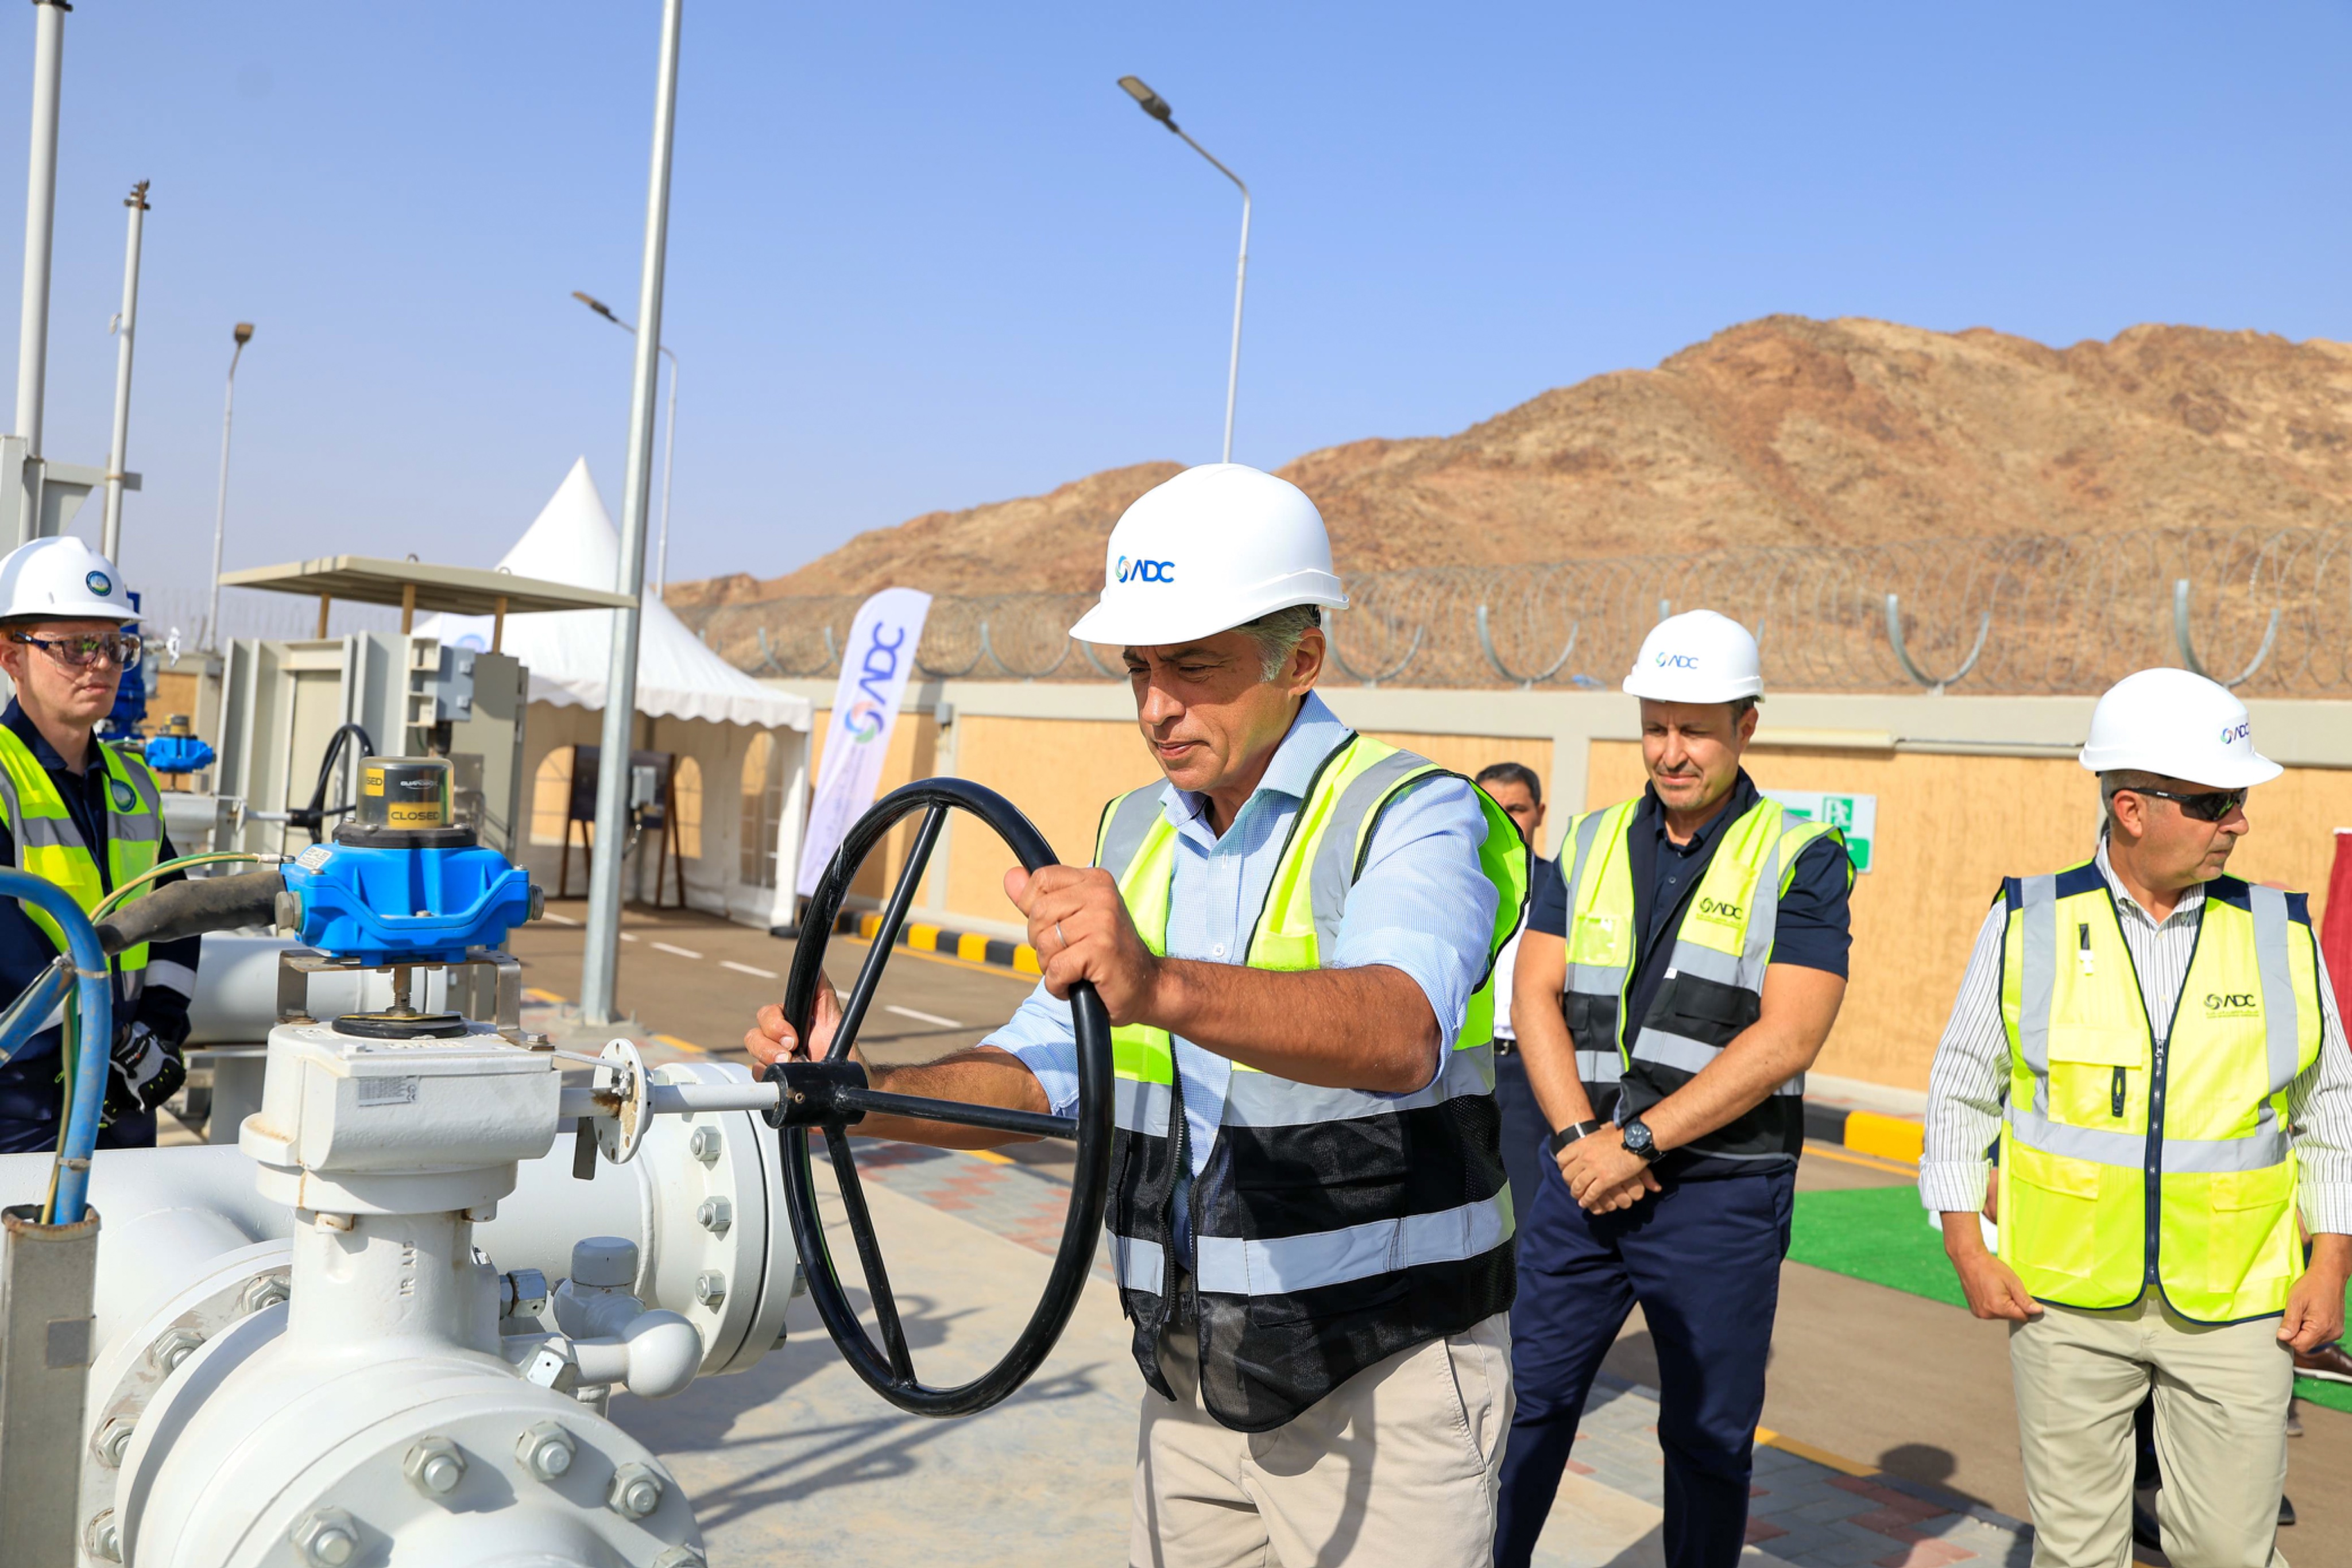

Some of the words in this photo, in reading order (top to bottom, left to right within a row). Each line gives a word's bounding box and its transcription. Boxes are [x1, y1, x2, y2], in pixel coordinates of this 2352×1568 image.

[1129, 559, 1175, 583] ADC
[859, 621, 904, 705] ADC
[1667, 655, 1699, 670] ADC
[2233, 722, 2249, 741] ADC
[391, 811, 440, 820] CLOSED
[1711, 901, 1743, 920] ADC
[2223, 994, 2256, 1008] ADC
